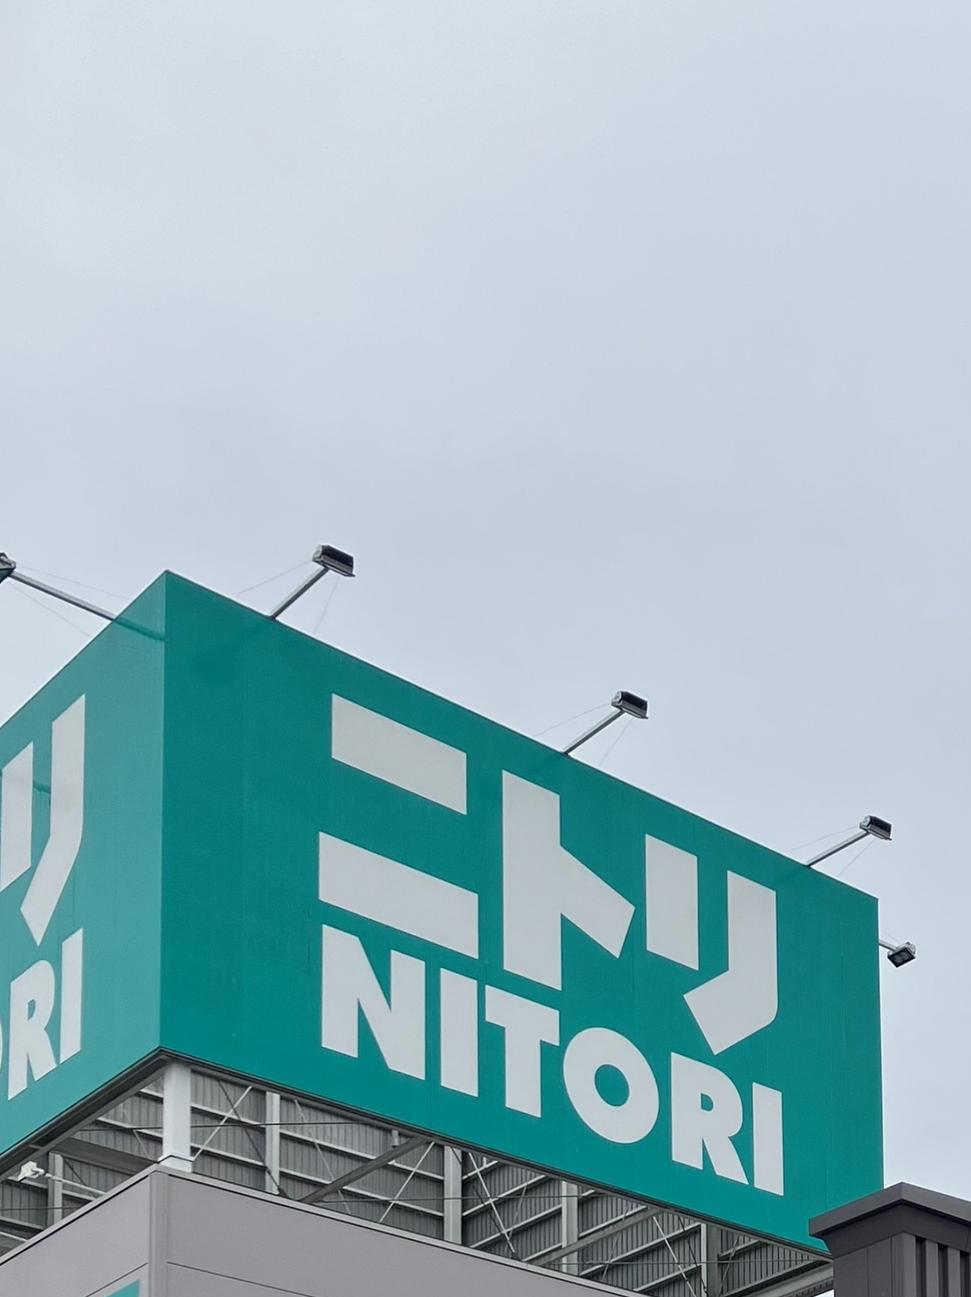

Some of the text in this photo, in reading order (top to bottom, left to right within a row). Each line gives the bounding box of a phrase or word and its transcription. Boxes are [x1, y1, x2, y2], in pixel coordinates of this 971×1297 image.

[319, 693, 778, 1055] ニトリ
[0, 927, 83, 1101] RI
[321, 924, 784, 1197] NITORI
